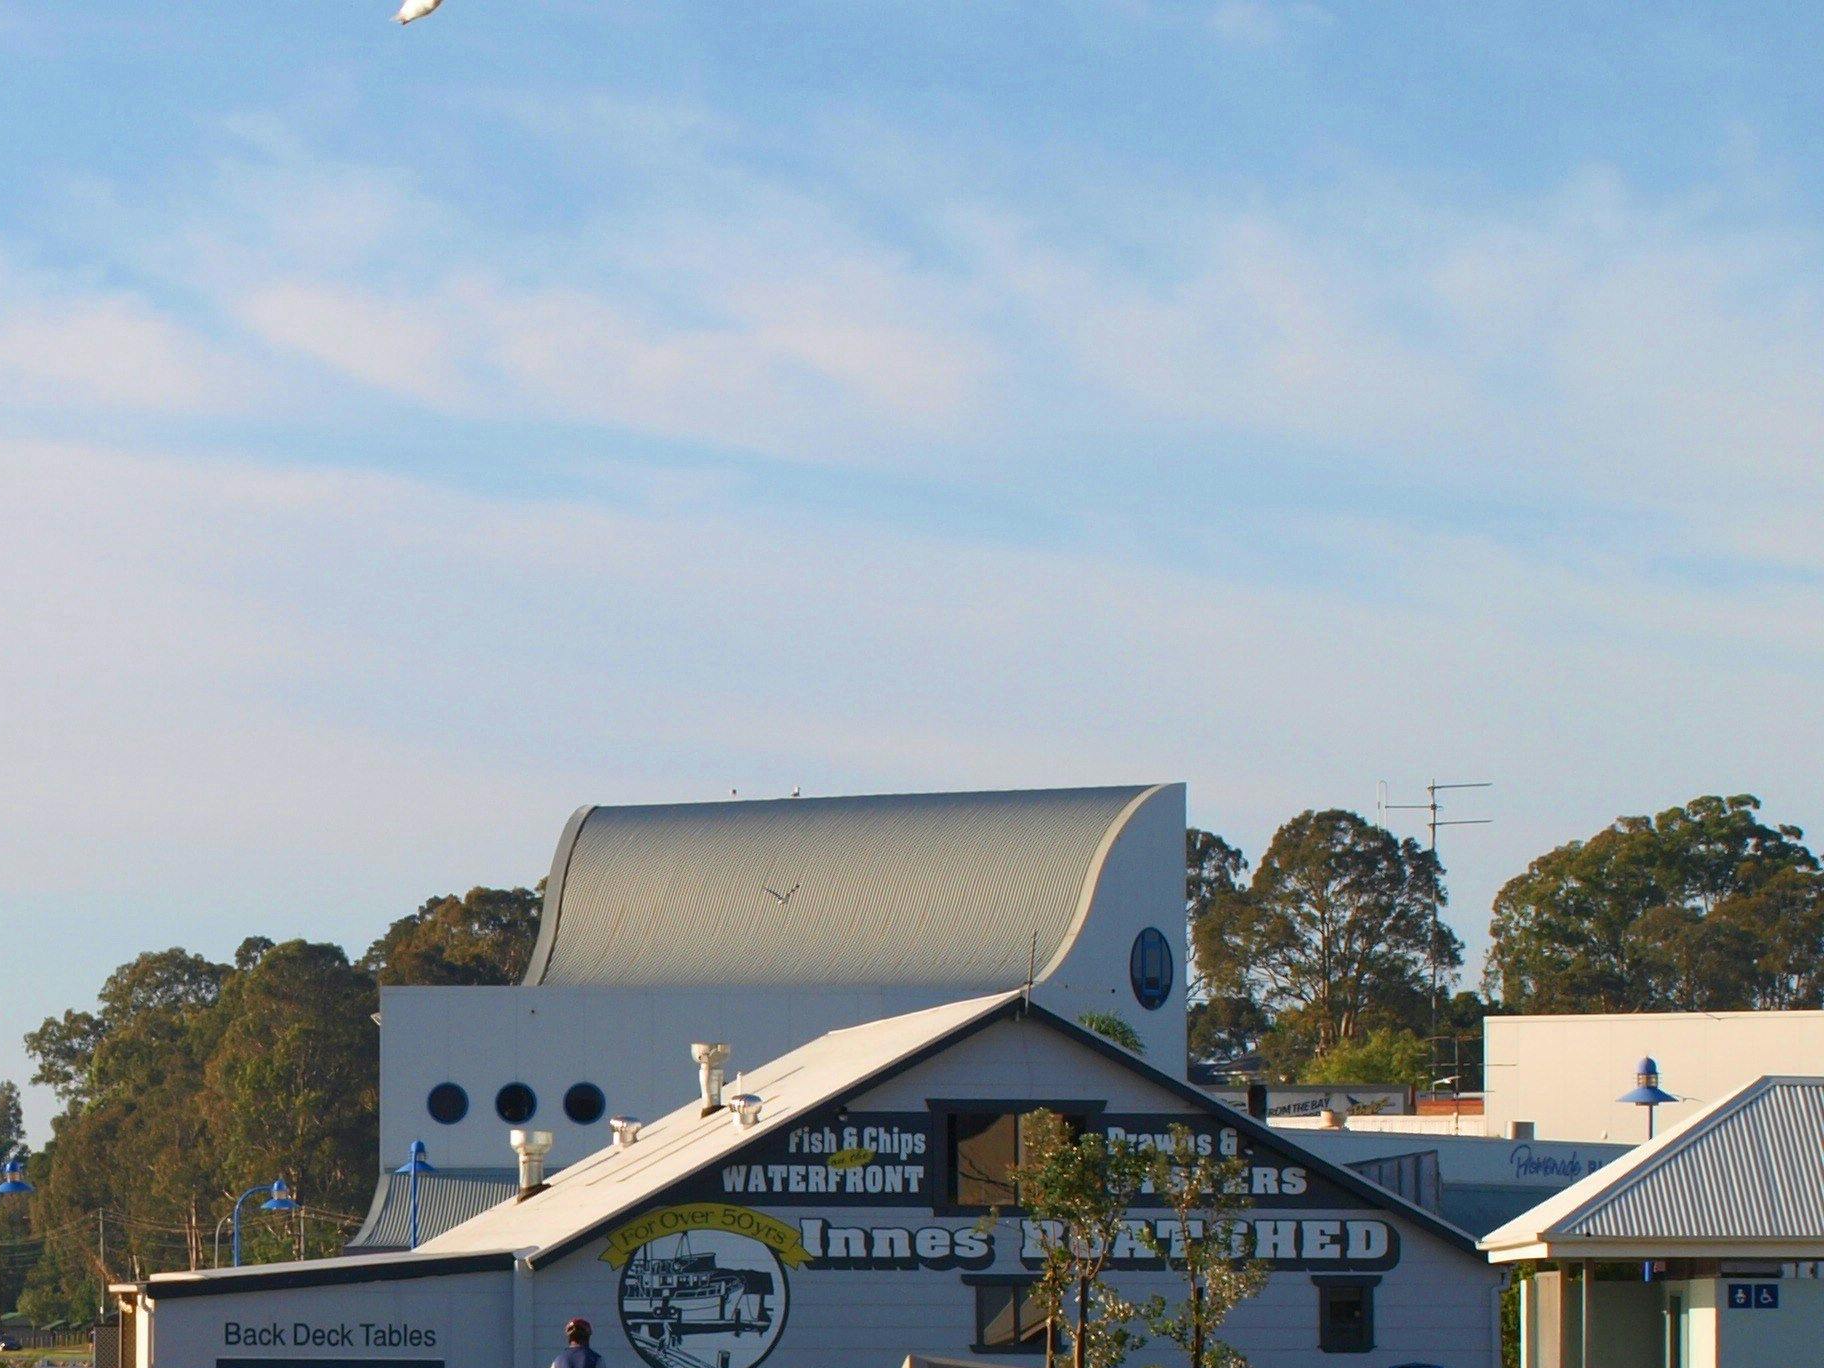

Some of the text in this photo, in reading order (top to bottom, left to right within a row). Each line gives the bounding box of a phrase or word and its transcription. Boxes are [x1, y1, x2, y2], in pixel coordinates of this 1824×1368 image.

[788, 1126, 927, 1161] Fish & Chips
[722, 1164, 925, 1194] WATERFRONT
[620, 1208, 785, 1247] For Over 50yrs
[799, 1217, 991, 1260] Innes
[224, 1322, 437, 1348] Back Deck Tables
